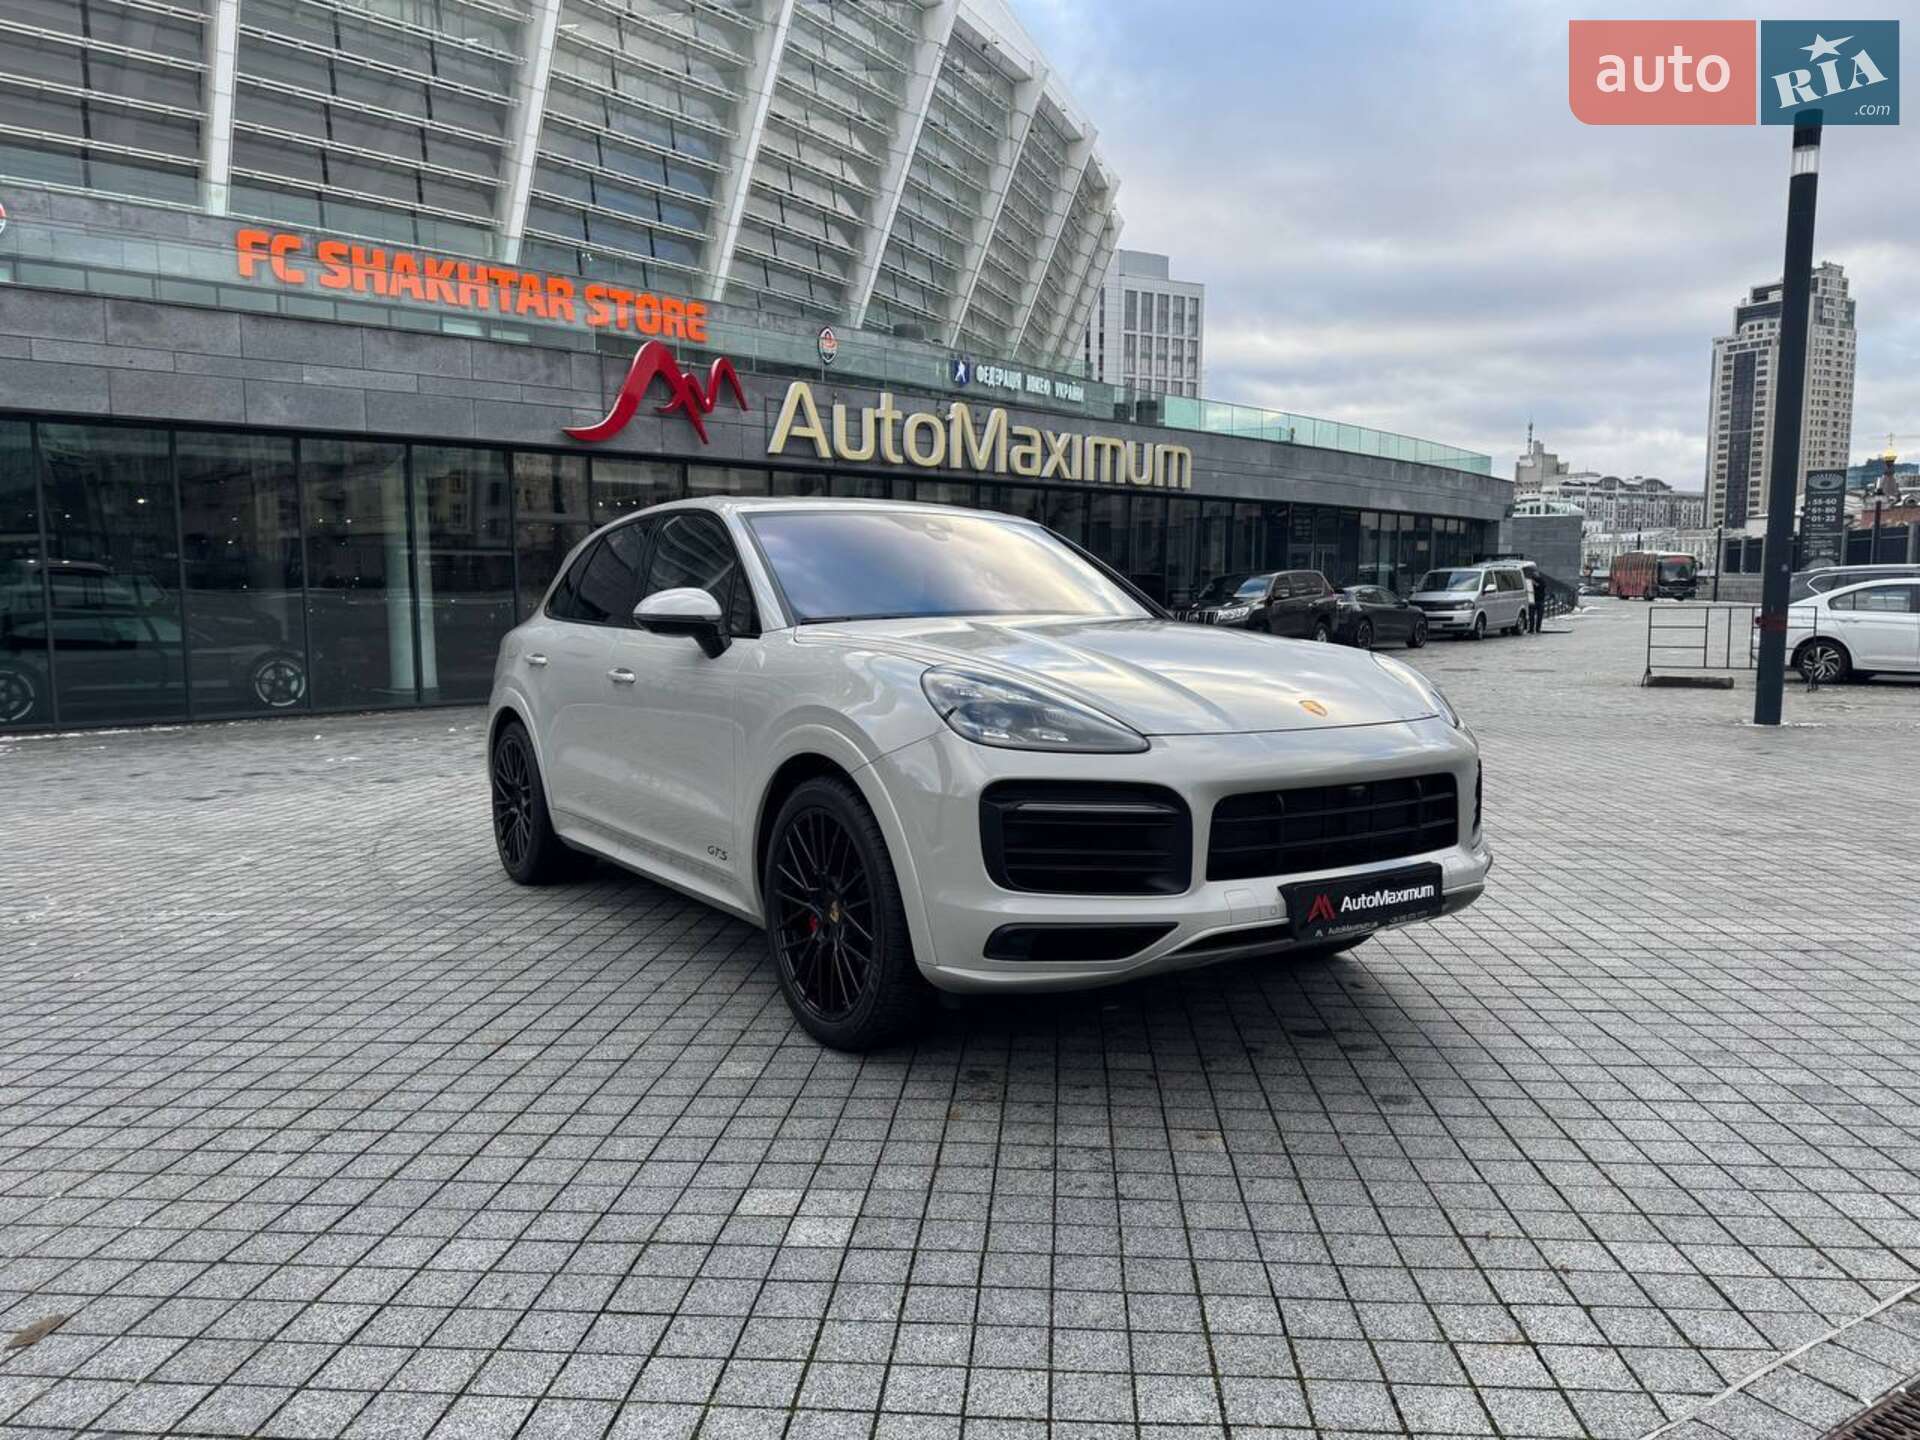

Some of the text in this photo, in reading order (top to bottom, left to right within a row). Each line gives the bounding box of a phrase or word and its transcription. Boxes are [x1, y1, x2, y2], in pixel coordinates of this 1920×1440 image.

[236, 228, 709, 343] FC SHAKHTAR STORE
[767, 380, 1192, 491] AutoMaximum
[707, 845, 728, 861] GTS
[1340, 884, 1435, 913] AutoMaximum
